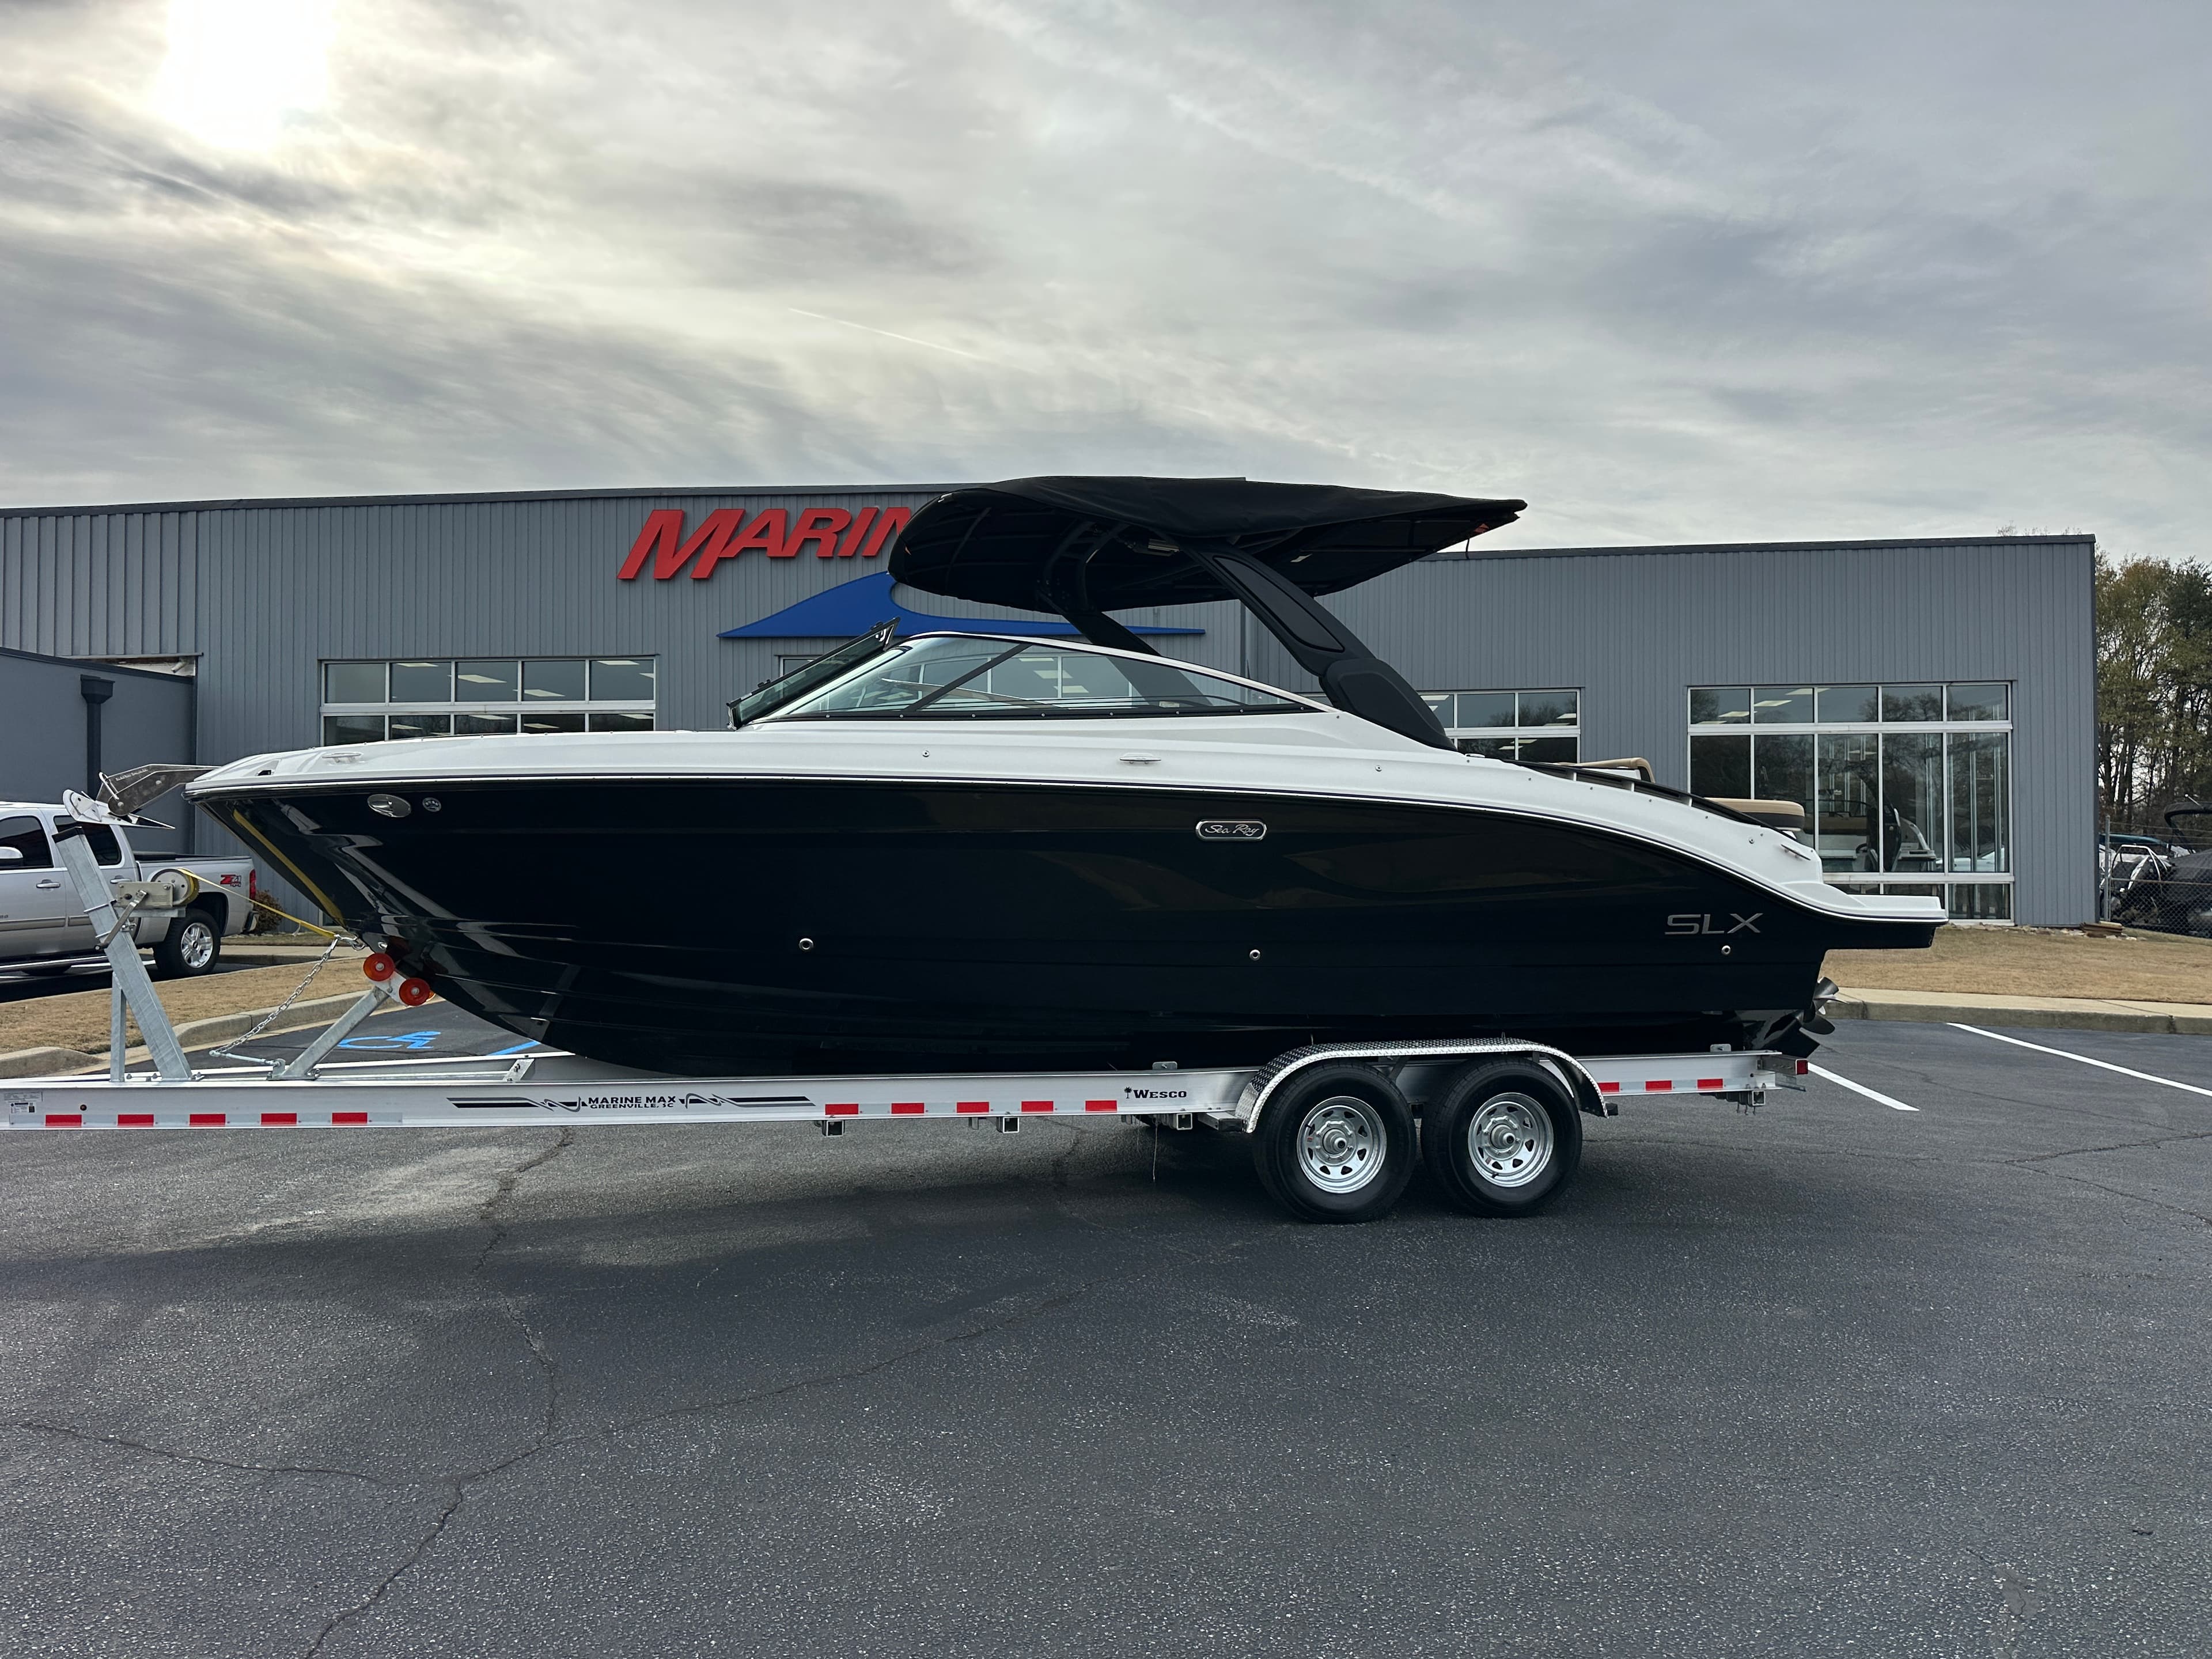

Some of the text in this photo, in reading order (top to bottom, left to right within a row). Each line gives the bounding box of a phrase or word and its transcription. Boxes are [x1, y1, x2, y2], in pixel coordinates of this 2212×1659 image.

[1205, 824, 1260, 836] Sea Ray
[1664, 912, 1764, 935] SLX
[588, 1096, 642, 1104] MARINE
